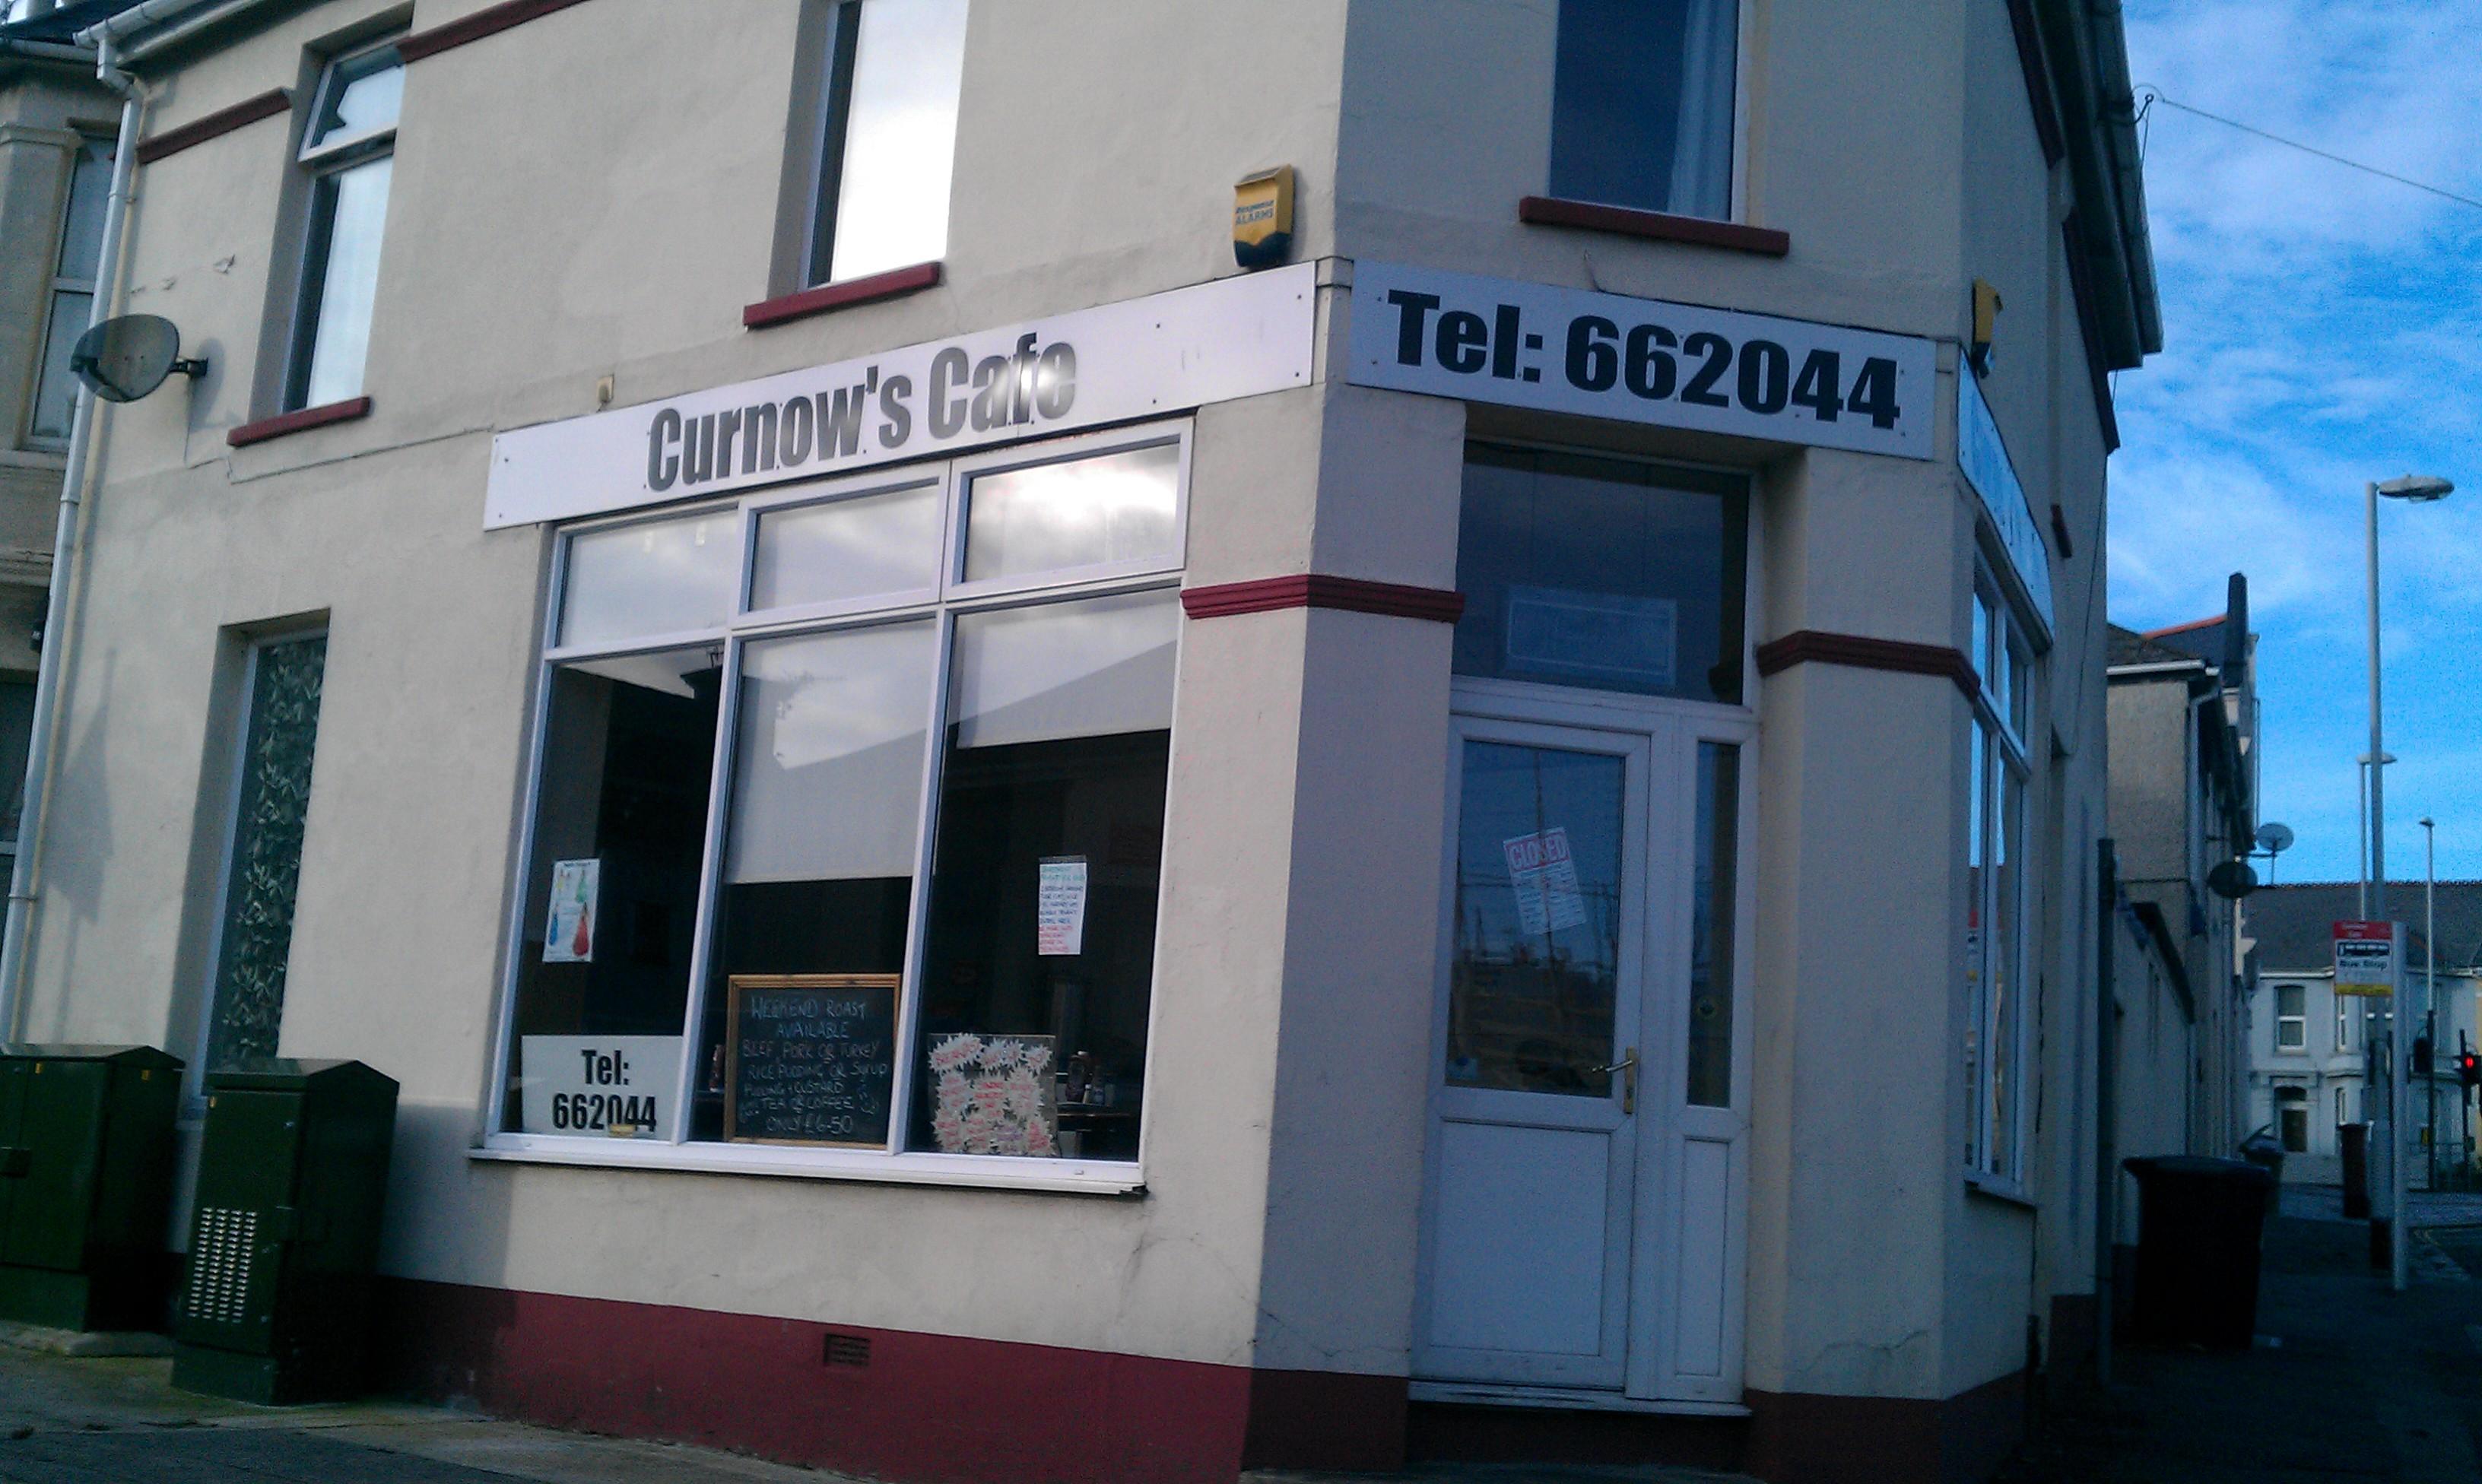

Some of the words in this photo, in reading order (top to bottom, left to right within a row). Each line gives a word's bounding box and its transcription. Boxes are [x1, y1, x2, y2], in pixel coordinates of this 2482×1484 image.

[1236, 207, 1274, 225] ALARMS
[1388, 289, 1543, 383] Tel:
[1564, 315, 1901, 430] 662044
[647, 365, 912, 492] Curnow's
[928, 332, 1077, 440] Cafe
[751, 996, 818, 1019] WEEKEND
[827, 999, 867, 1020] ROAST
[776, 1021, 850, 1039] AVAILABLE
[581, 1049, 630, 1086] Tel:
[552, 1092, 657, 1132] 662044
